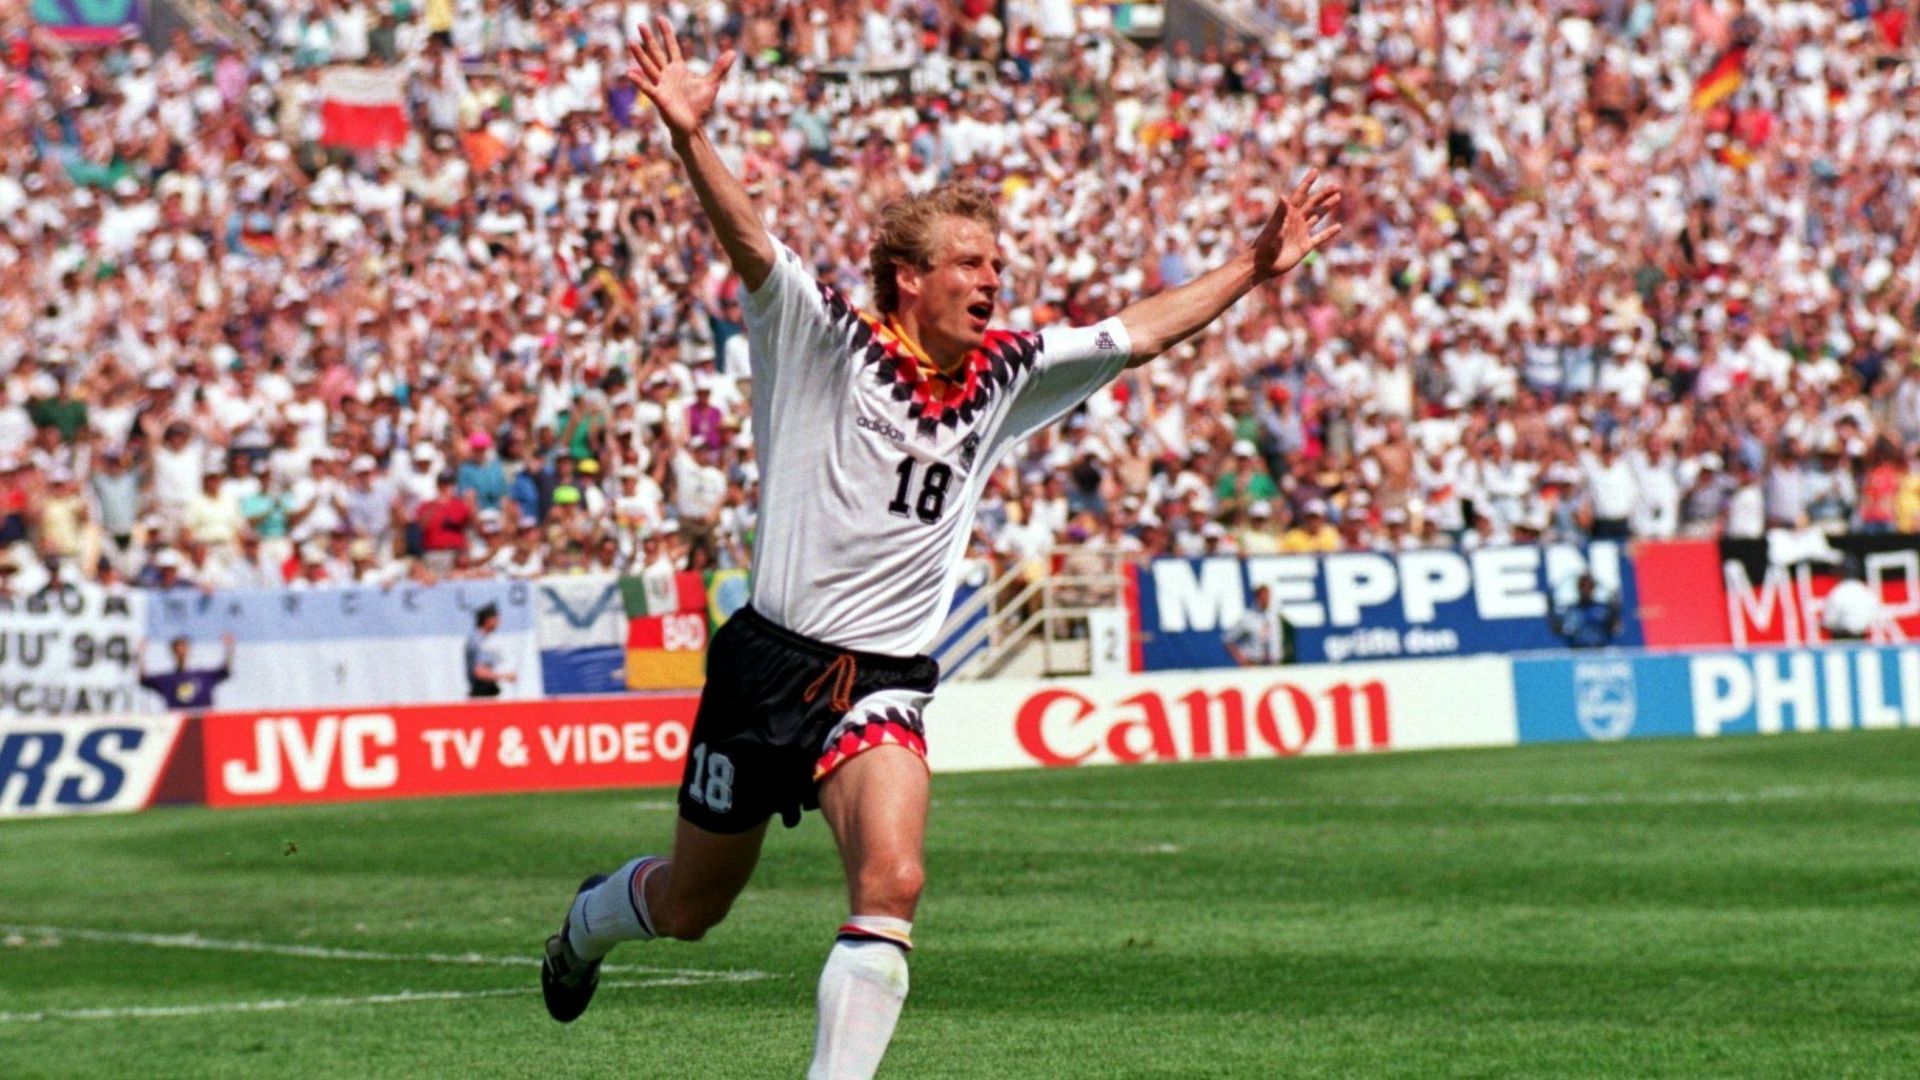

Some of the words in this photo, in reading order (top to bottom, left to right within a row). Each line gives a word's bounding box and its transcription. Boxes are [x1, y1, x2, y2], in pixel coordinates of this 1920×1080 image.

[856, 416, 906, 442] adidas
[888, 456, 952, 525] 18
[1153, 544, 1624, 632] MEPPEN
[1404, 624, 1459, 654] den
[222, 713, 399, 795] JVC
[421, 728, 484, 770] TV
[498, 726, 529, 767] &
[540, 720, 688, 765] VIDEO
[1016, 679, 1391, 767] Canon
[0, 728, 146, 807] RS
[689, 742, 735, 814] 18
